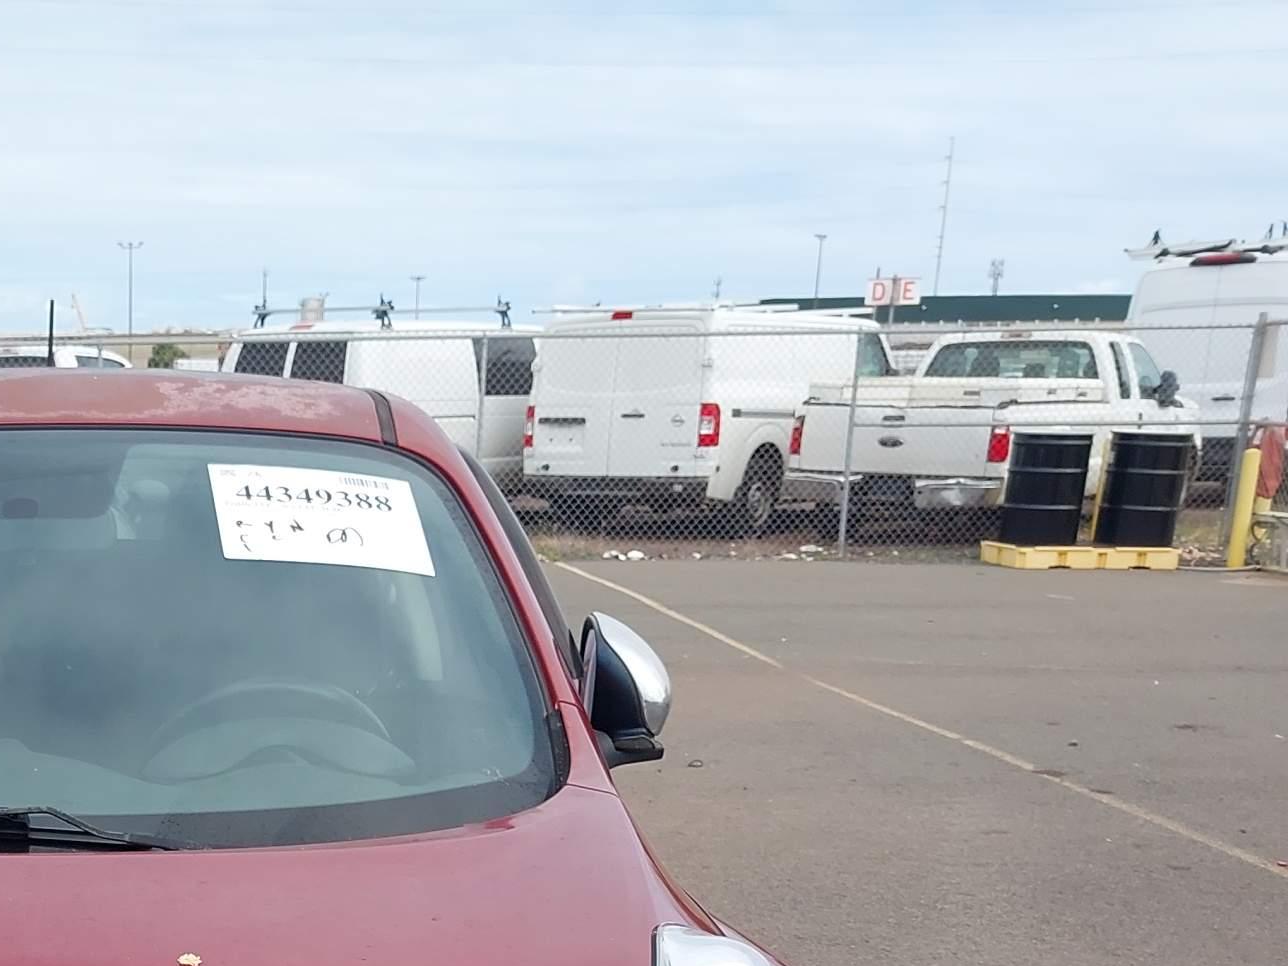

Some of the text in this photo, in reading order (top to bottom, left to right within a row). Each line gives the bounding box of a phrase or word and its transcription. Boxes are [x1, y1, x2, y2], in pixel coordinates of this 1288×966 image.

[872, 281, 916, 301] D E
[235, 484, 393, 511] 44349388
